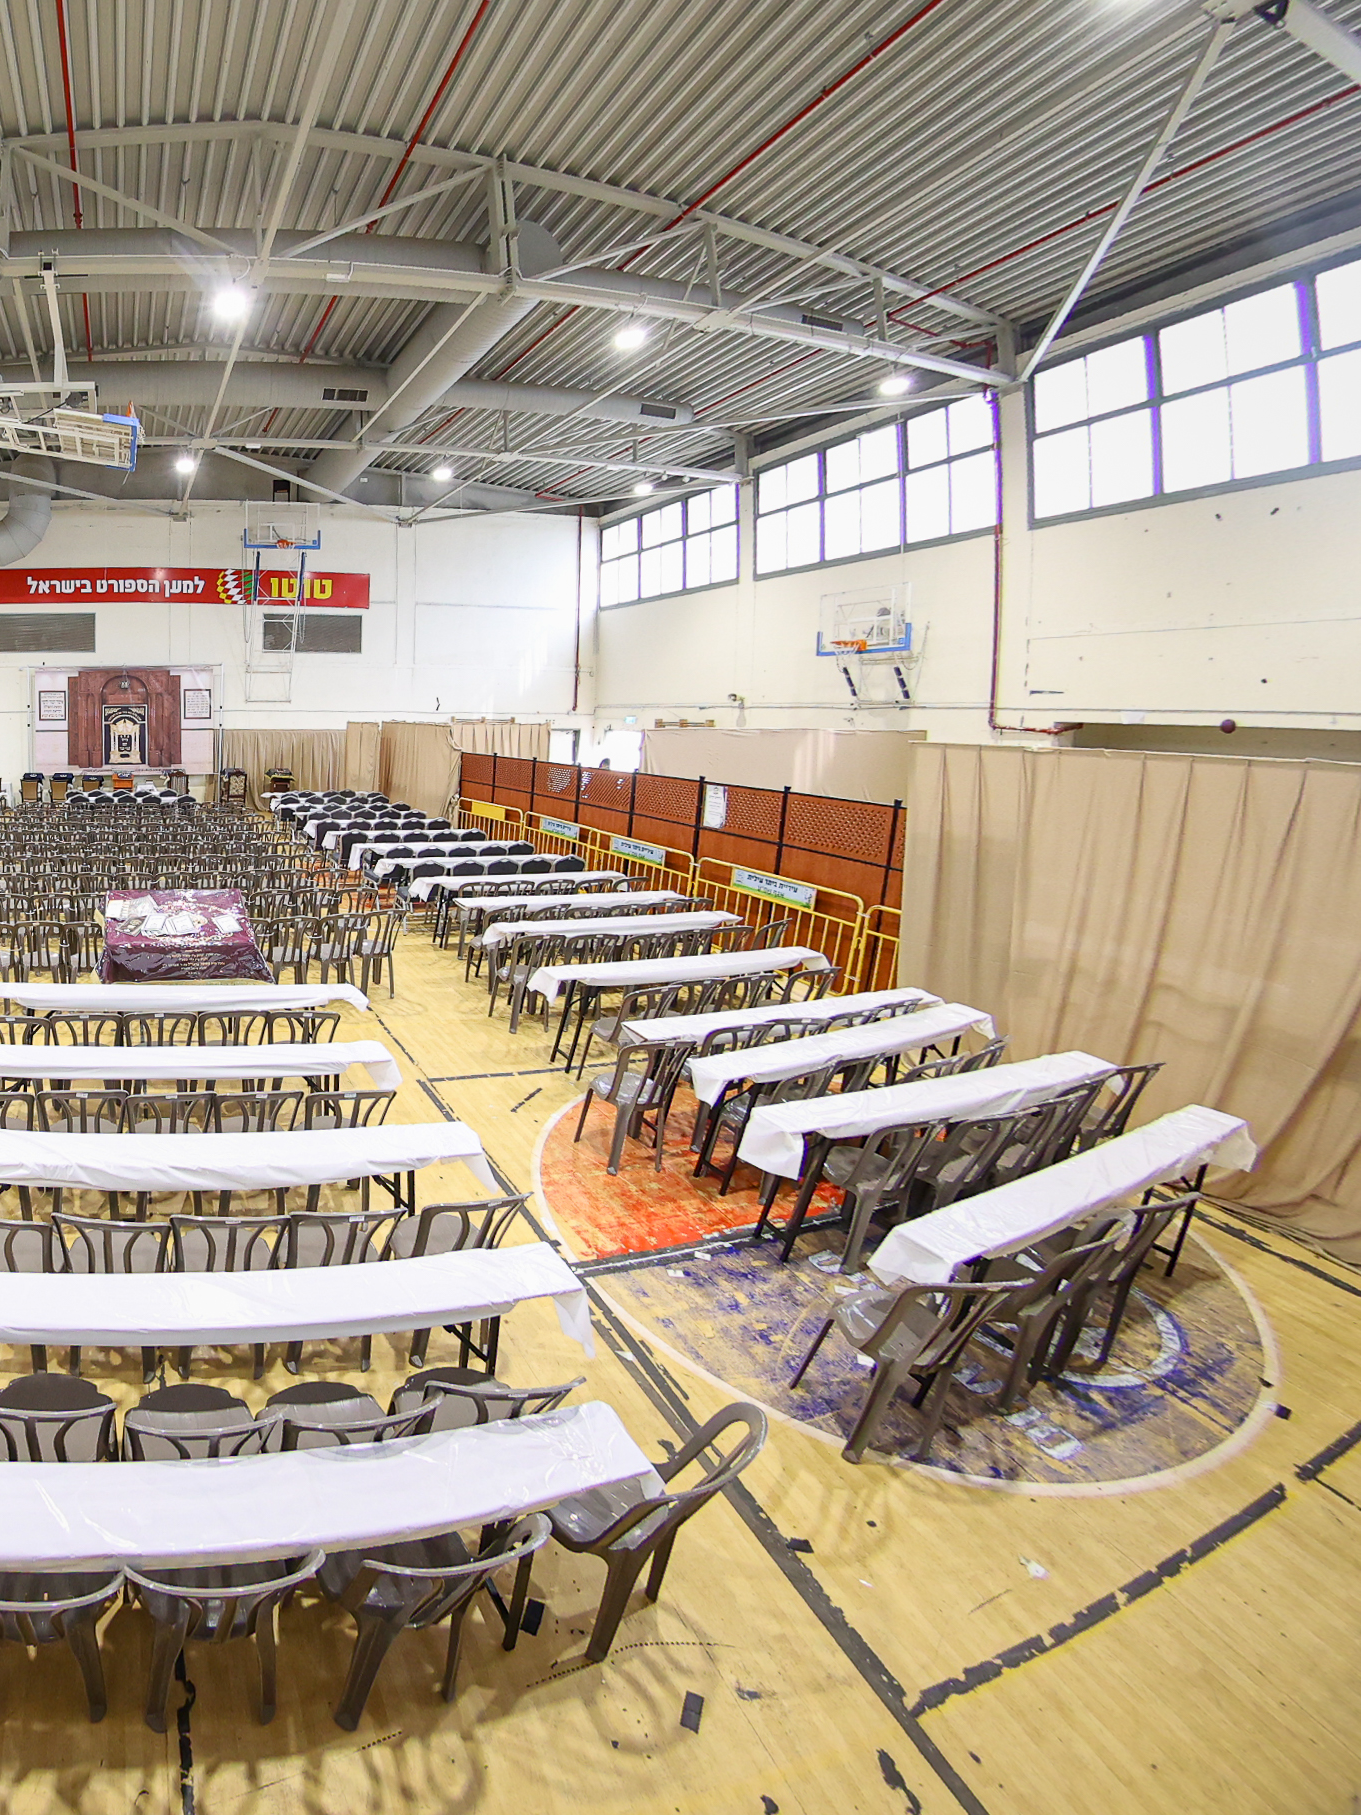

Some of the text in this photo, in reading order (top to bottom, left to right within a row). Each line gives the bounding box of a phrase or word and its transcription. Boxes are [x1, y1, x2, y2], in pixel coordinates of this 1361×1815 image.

[27, 576, 206, 598] למען הספורט בישראל
[270, 577, 333, 599] טוטו
[747, 874, 763, 884] עילית
[779, 883, 798, 893] עיריית
